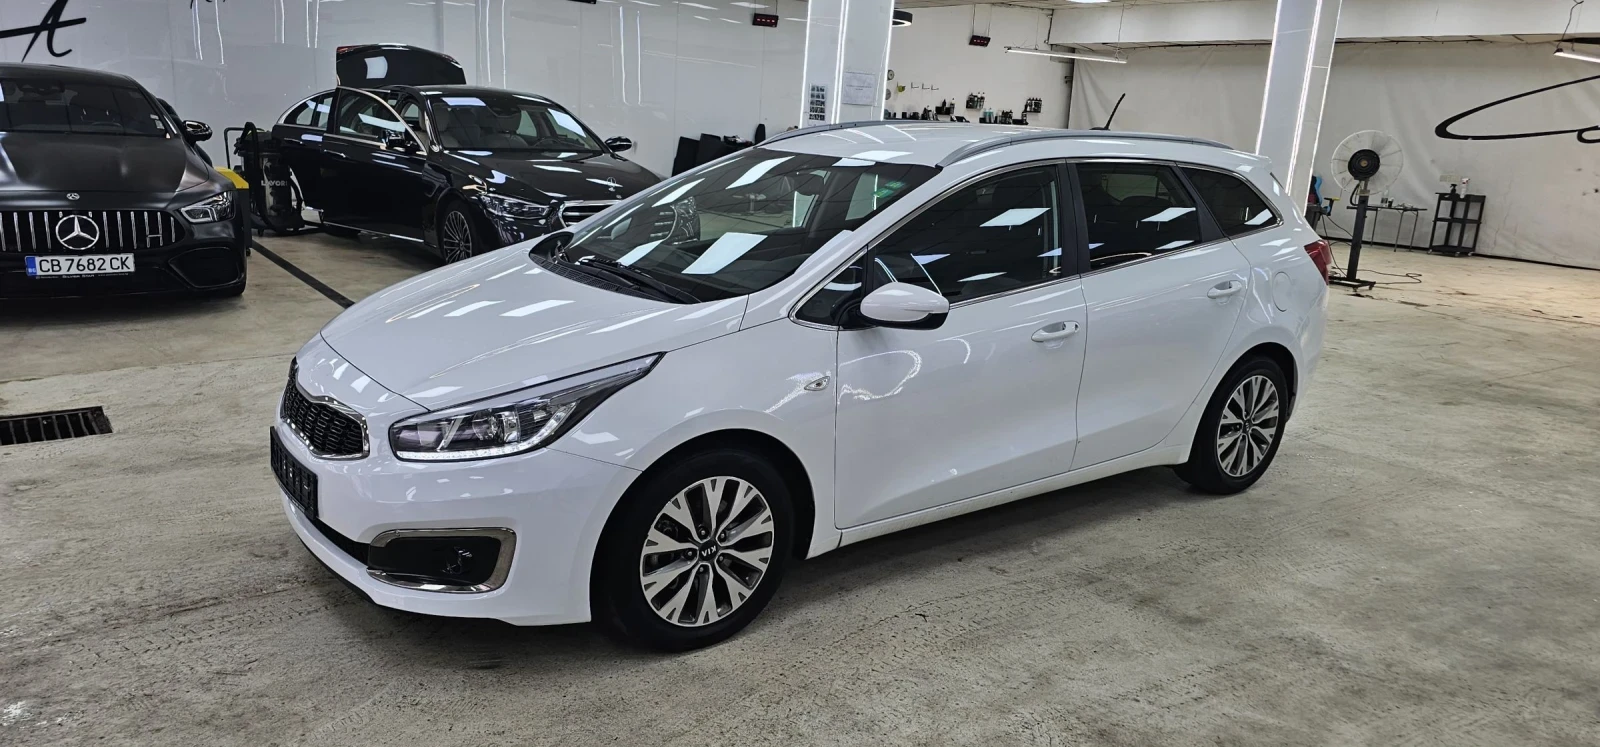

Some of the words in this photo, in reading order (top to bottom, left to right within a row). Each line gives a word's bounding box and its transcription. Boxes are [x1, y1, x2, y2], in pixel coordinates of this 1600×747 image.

[39, 259, 62, 273] CB
[65, 257, 106, 272] 7682
[109, 256, 130, 270] CK
[701, 545, 716, 557] KIA
